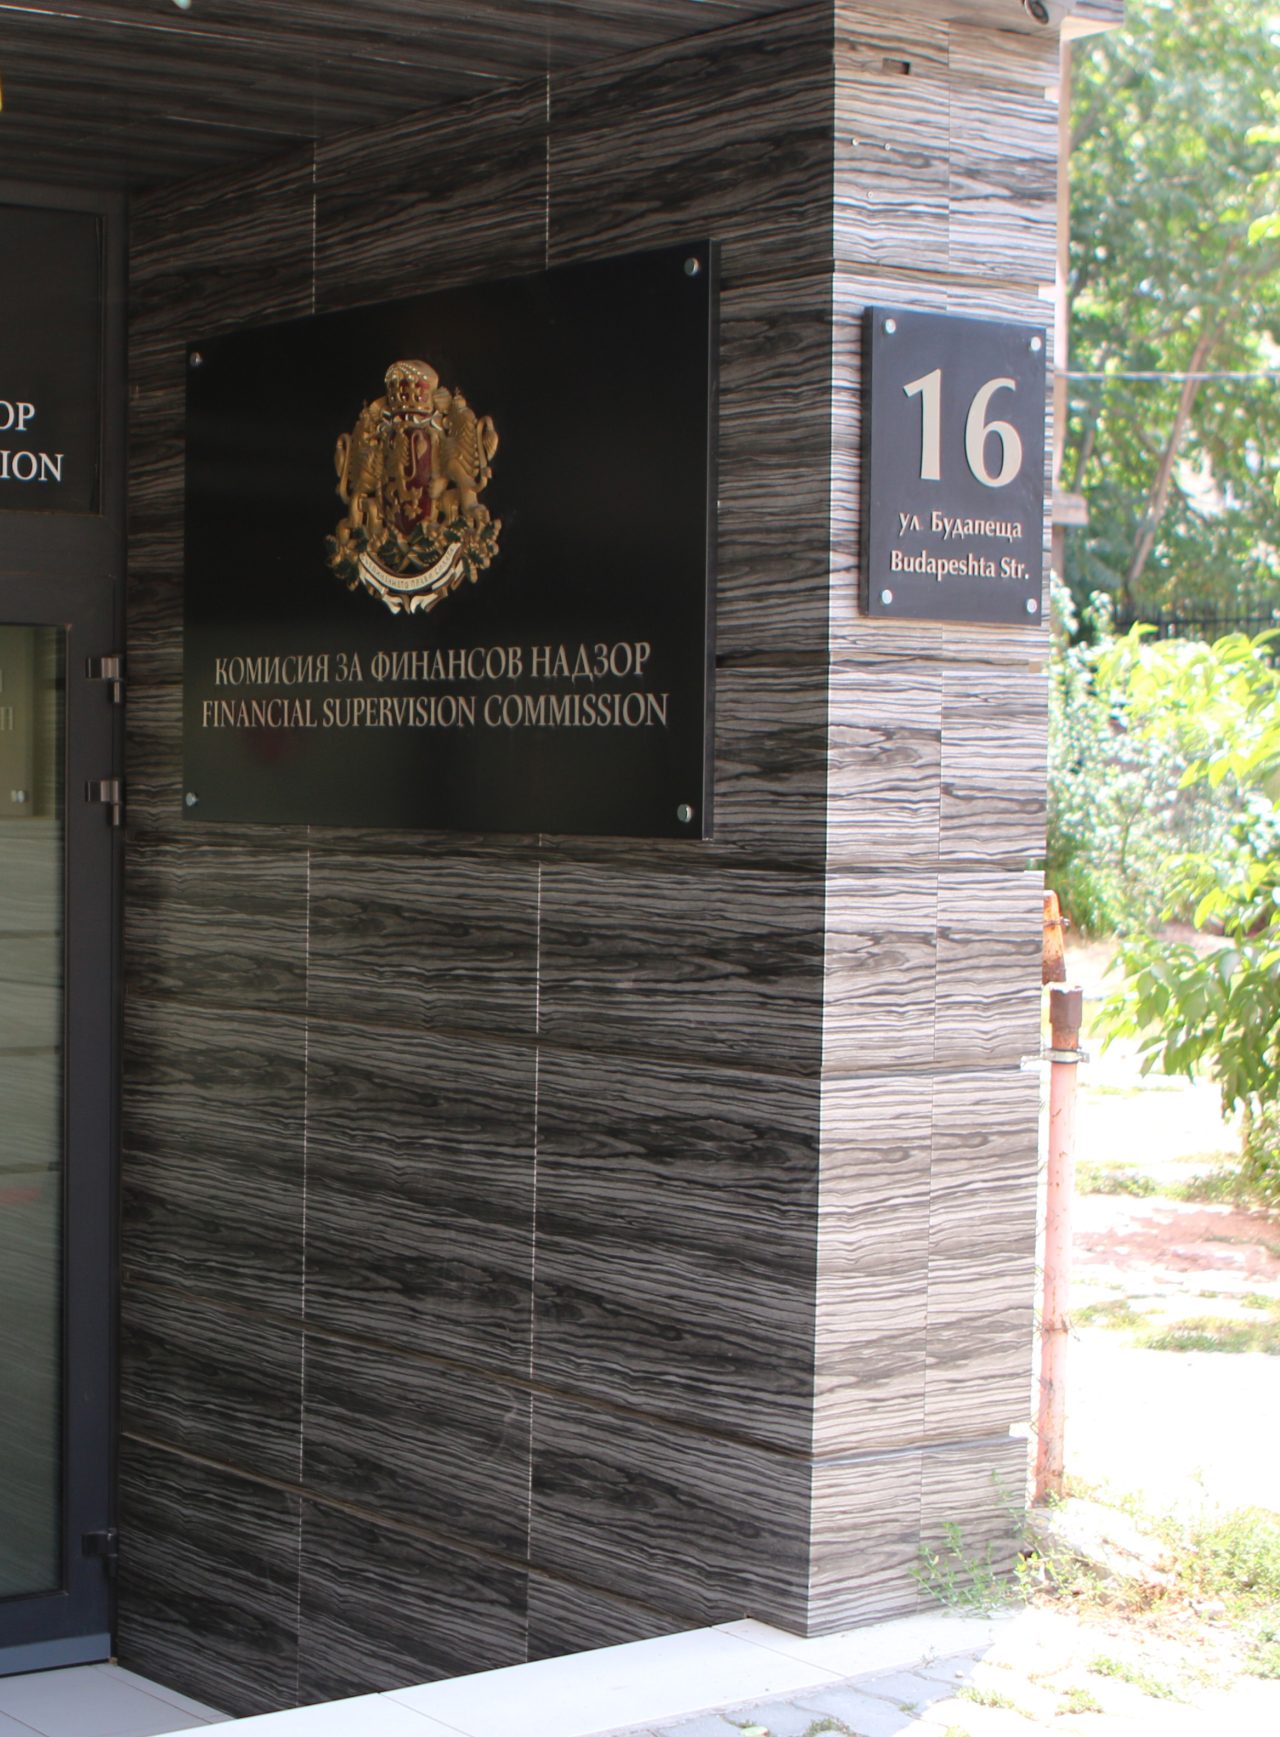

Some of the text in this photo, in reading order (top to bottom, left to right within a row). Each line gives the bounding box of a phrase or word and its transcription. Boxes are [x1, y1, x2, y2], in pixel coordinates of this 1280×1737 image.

[903, 368, 1023, 488] 16
[931, 510, 1023, 543] Будапеща
[890, 549, 1030, 582] Budapeshta Str.
[215, 641, 651, 686] КОМИСИЯ ЗА ФИНАНСОВ НАДЗОР
[202, 692, 669, 729] FINANCIAL SUPERVISION COMMISSION
